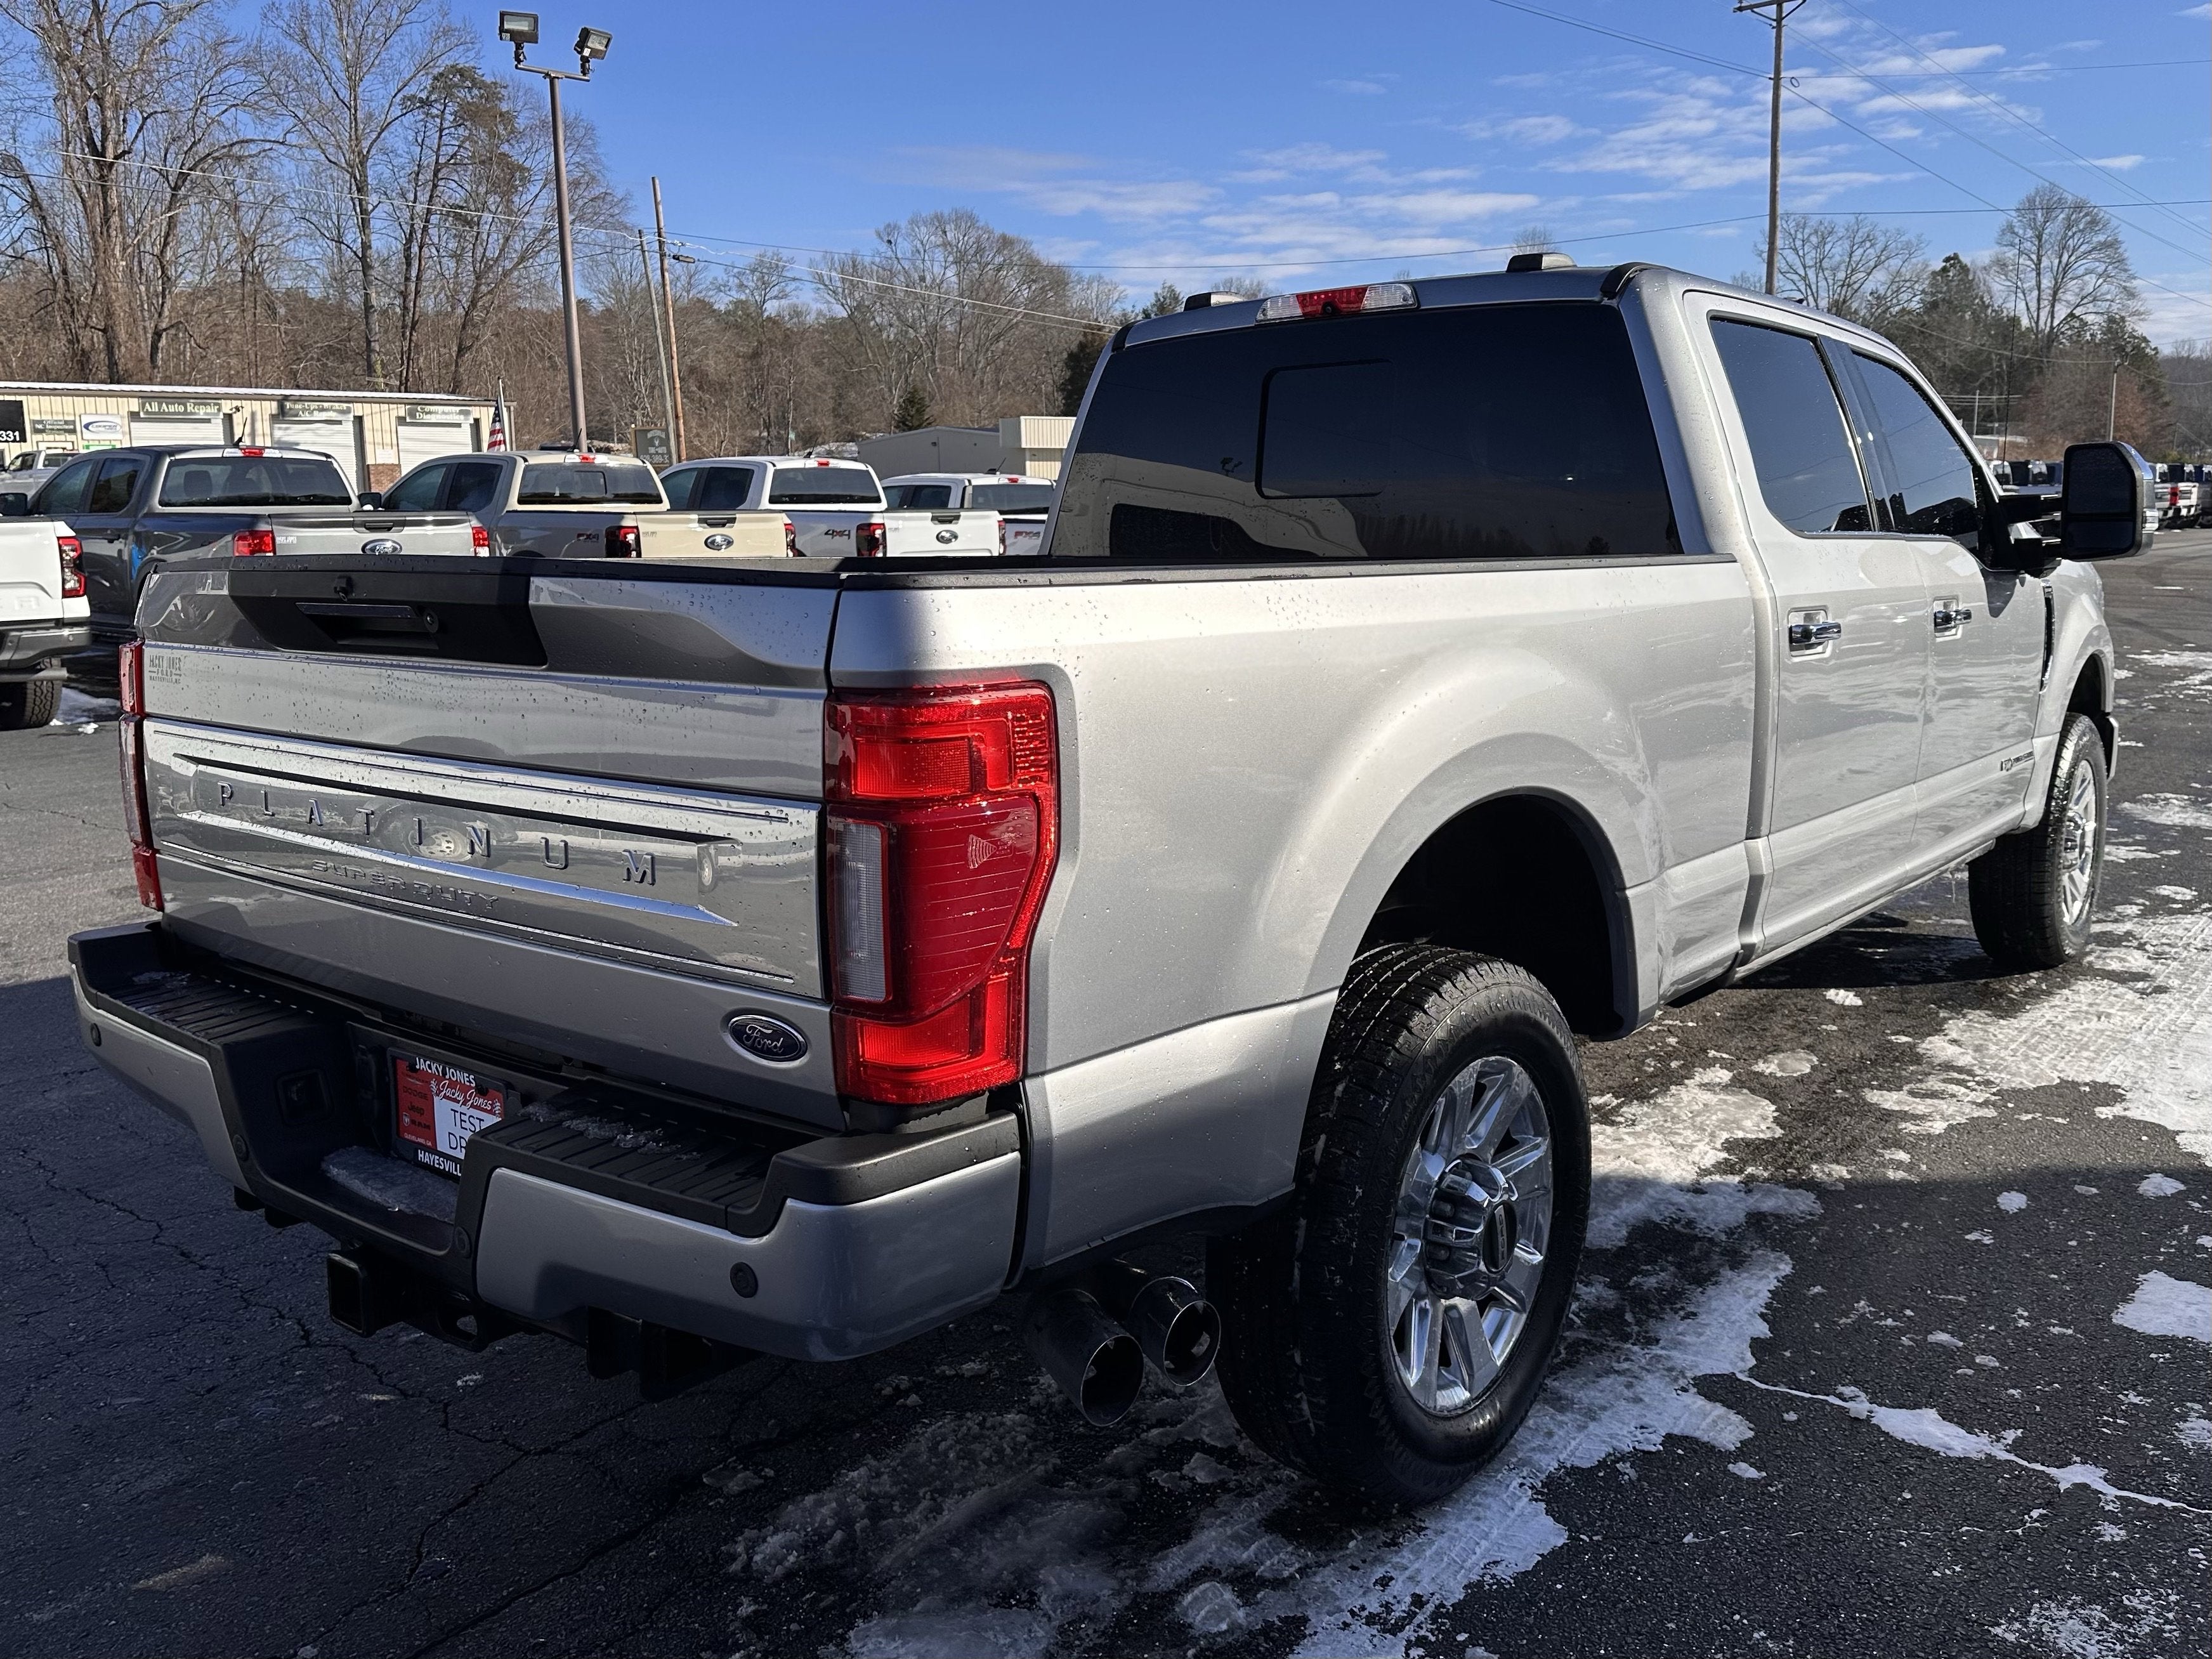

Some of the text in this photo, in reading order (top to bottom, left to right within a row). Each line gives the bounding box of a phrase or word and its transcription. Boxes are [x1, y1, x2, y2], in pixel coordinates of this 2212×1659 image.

[143, 402, 219, 416] All Auto Repair
[0, 431, 20, 442] 331
[218, 781, 657, 886] PLATINUM
[311, 858, 499, 910] SUPER DUTY
[742, 1024, 784, 1053] Ford
[416, 1056, 443, 1077] JACKY
[445, 1068, 476, 1087] JONES
[402, 1085, 429, 1101] DODGE
[438, 1079, 492, 1110] Jacky Jones
[408, 1103, 425, 1117] Jeep
[450, 1108, 485, 1133] TEST
[448, 1131, 468, 1154] DR
[417, 1149, 462, 1177] HAYESVILL
